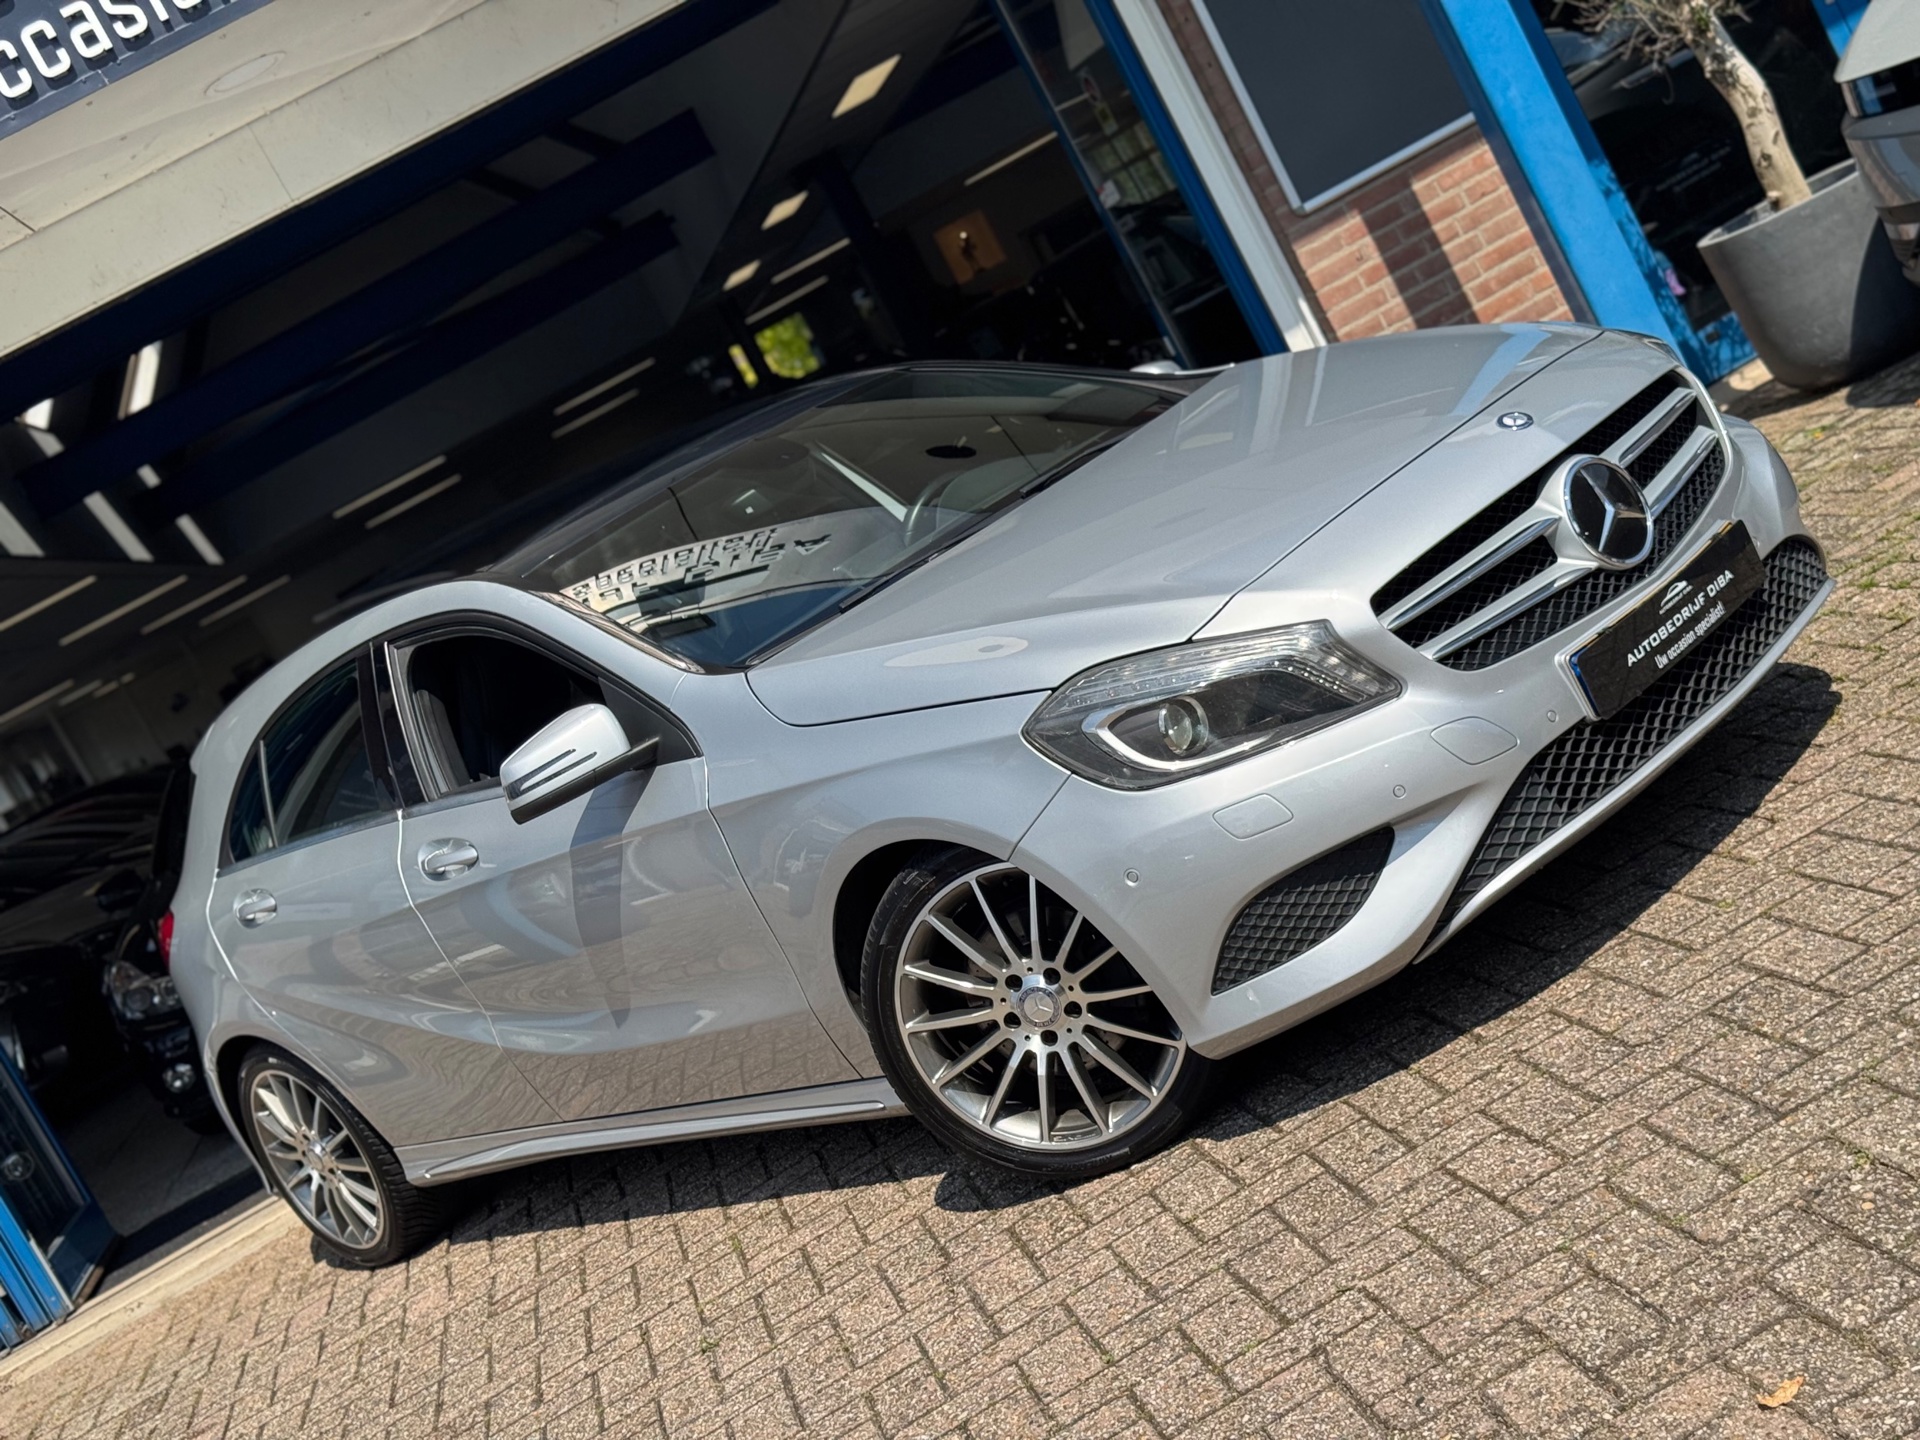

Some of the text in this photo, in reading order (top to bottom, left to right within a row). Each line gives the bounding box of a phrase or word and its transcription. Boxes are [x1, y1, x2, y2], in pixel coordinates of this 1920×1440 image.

[0, 0, 203, 98] ccas
[1626, 591, 1706, 668] AUTOBEDRIJF
[1706, 569, 1735, 598] DIBA
[1654, 600, 1727, 669] Uw occasion specialist!
